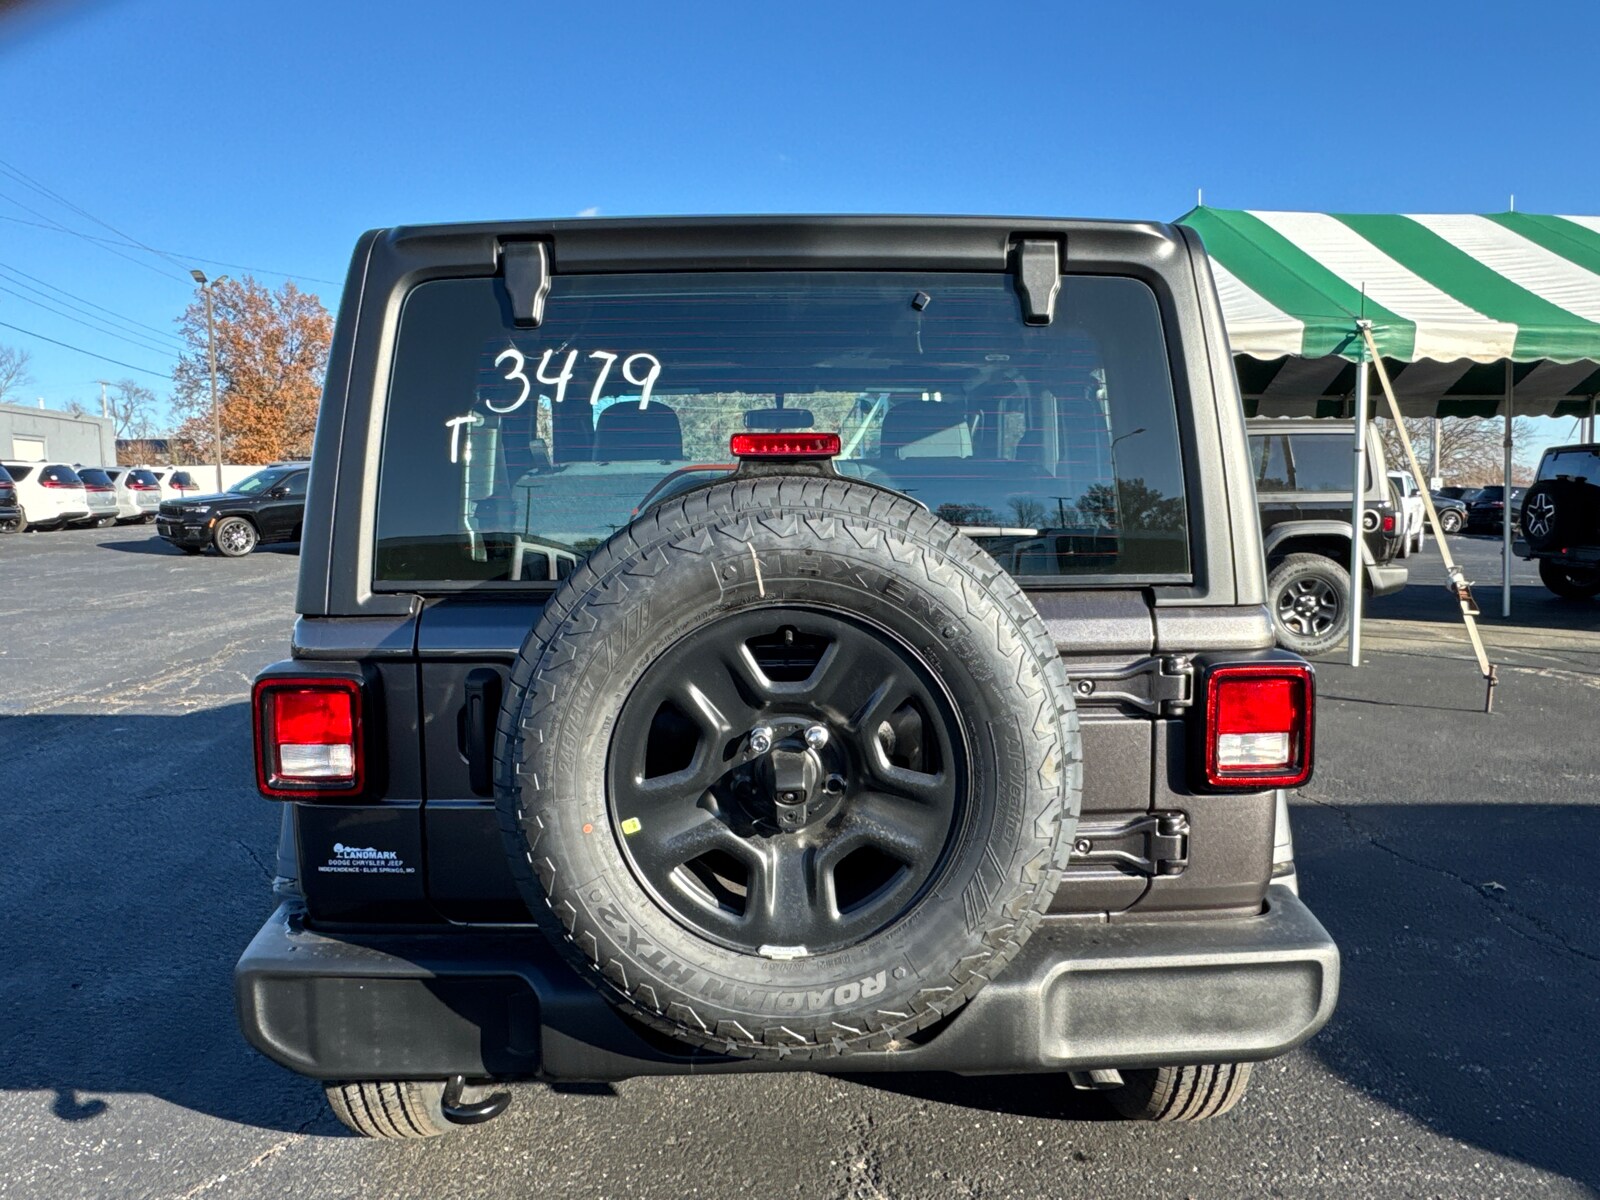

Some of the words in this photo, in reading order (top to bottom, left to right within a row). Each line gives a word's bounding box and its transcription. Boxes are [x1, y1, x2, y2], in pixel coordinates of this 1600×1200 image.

[485, 348, 662, 413] 3479
[742, 553, 949, 629] NEXEN
[558, 675, 595, 776] 245/75R17
[343, 850, 398, 860] LANDMARK
[351, 859, 386, 867] CHRYSLER
[597, 902, 698, 985] HTX2
[698, 969, 888, 1014] ROADIAN
